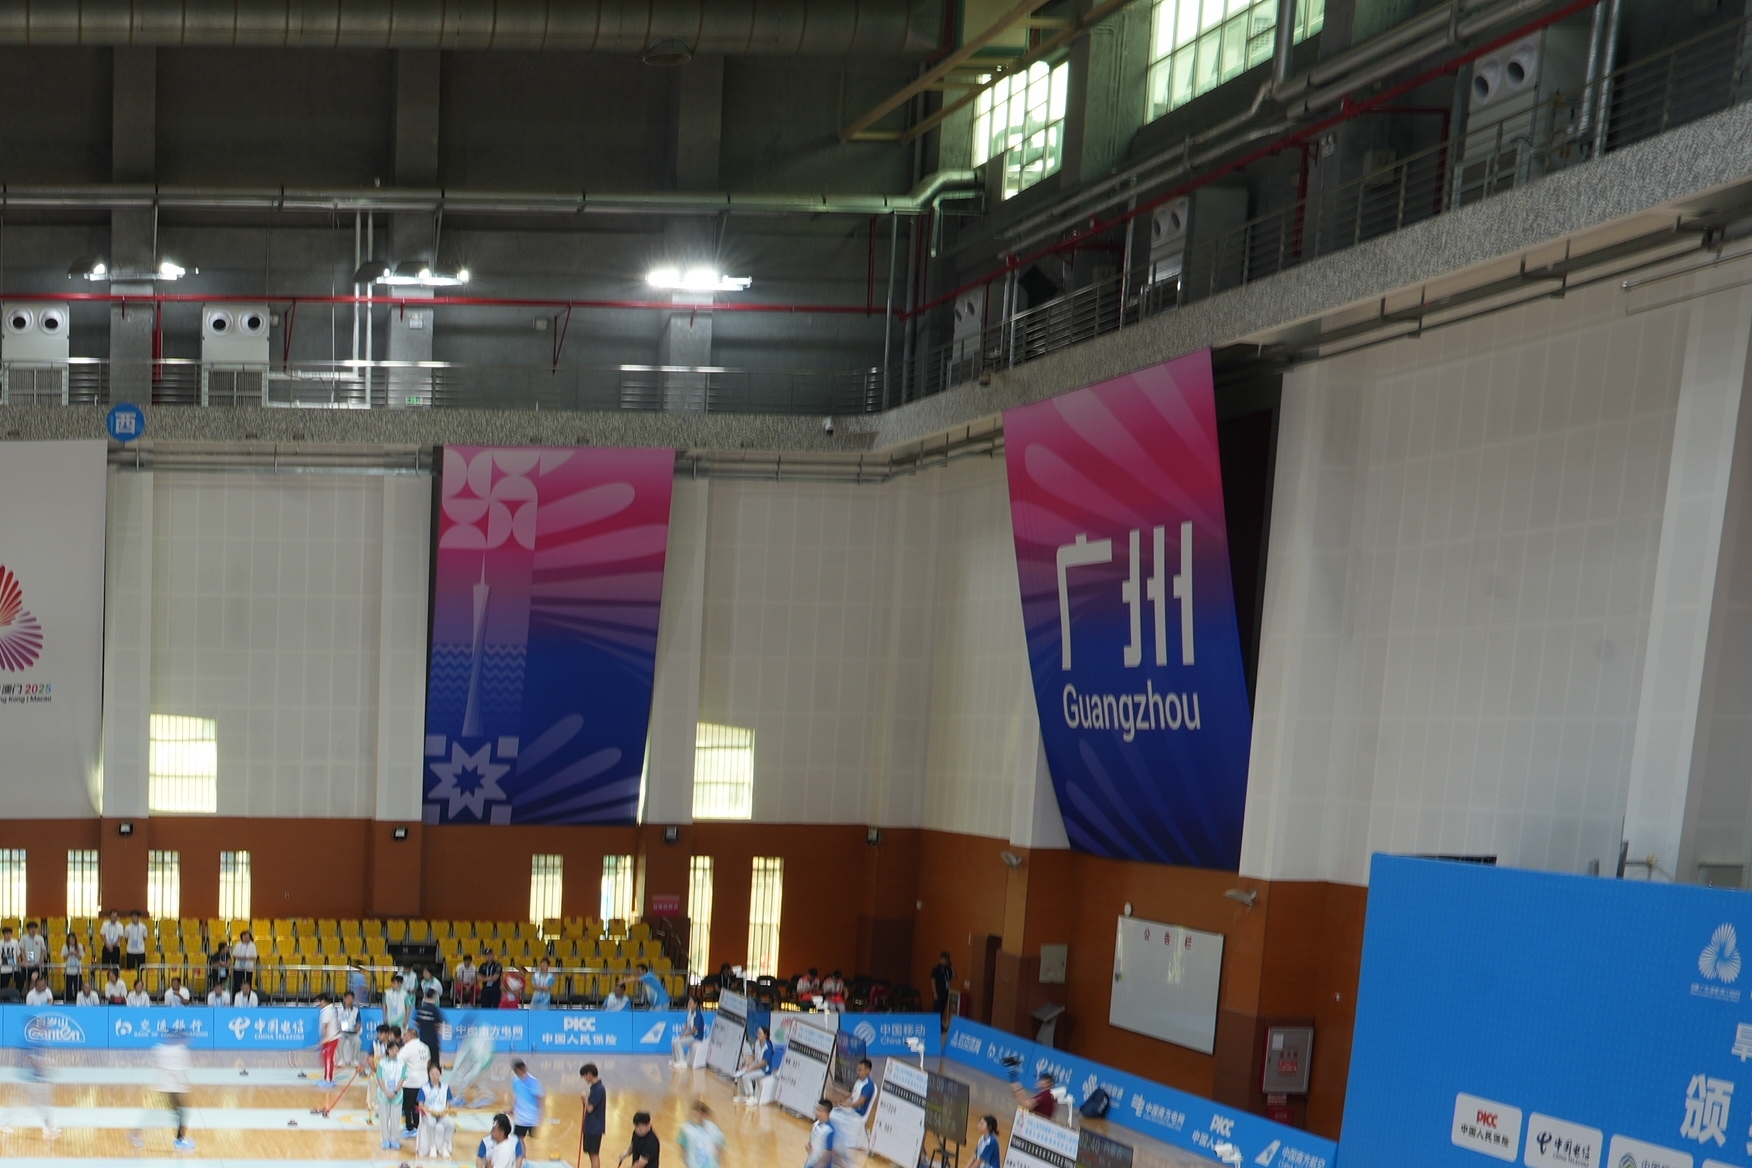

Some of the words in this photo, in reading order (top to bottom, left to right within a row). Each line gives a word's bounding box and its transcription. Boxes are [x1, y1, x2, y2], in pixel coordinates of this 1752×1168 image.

[115, 411, 136, 435] 西
[1056, 521, 1194, 671] 广州
[25, 683, 52, 696] 2025
[1062, 680, 1201, 744] Guangzhou
[254, 1019, 304, 1034] 中国电信
[564, 1016, 595, 1031] PICC
[880, 1023, 925, 1037] 中国移动
[542, 1032, 617, 1046] 中国人民保险
[1210, 1114, 1235, 1138] PICC
[1476, 1109, 1498, 1130] PICC
[1680, 1072, 1752, 1156] 颁
[1461, 1123, 1510, 1148] 中国人民保险
[1554, 1137, 1591, 1161] 中国电信
